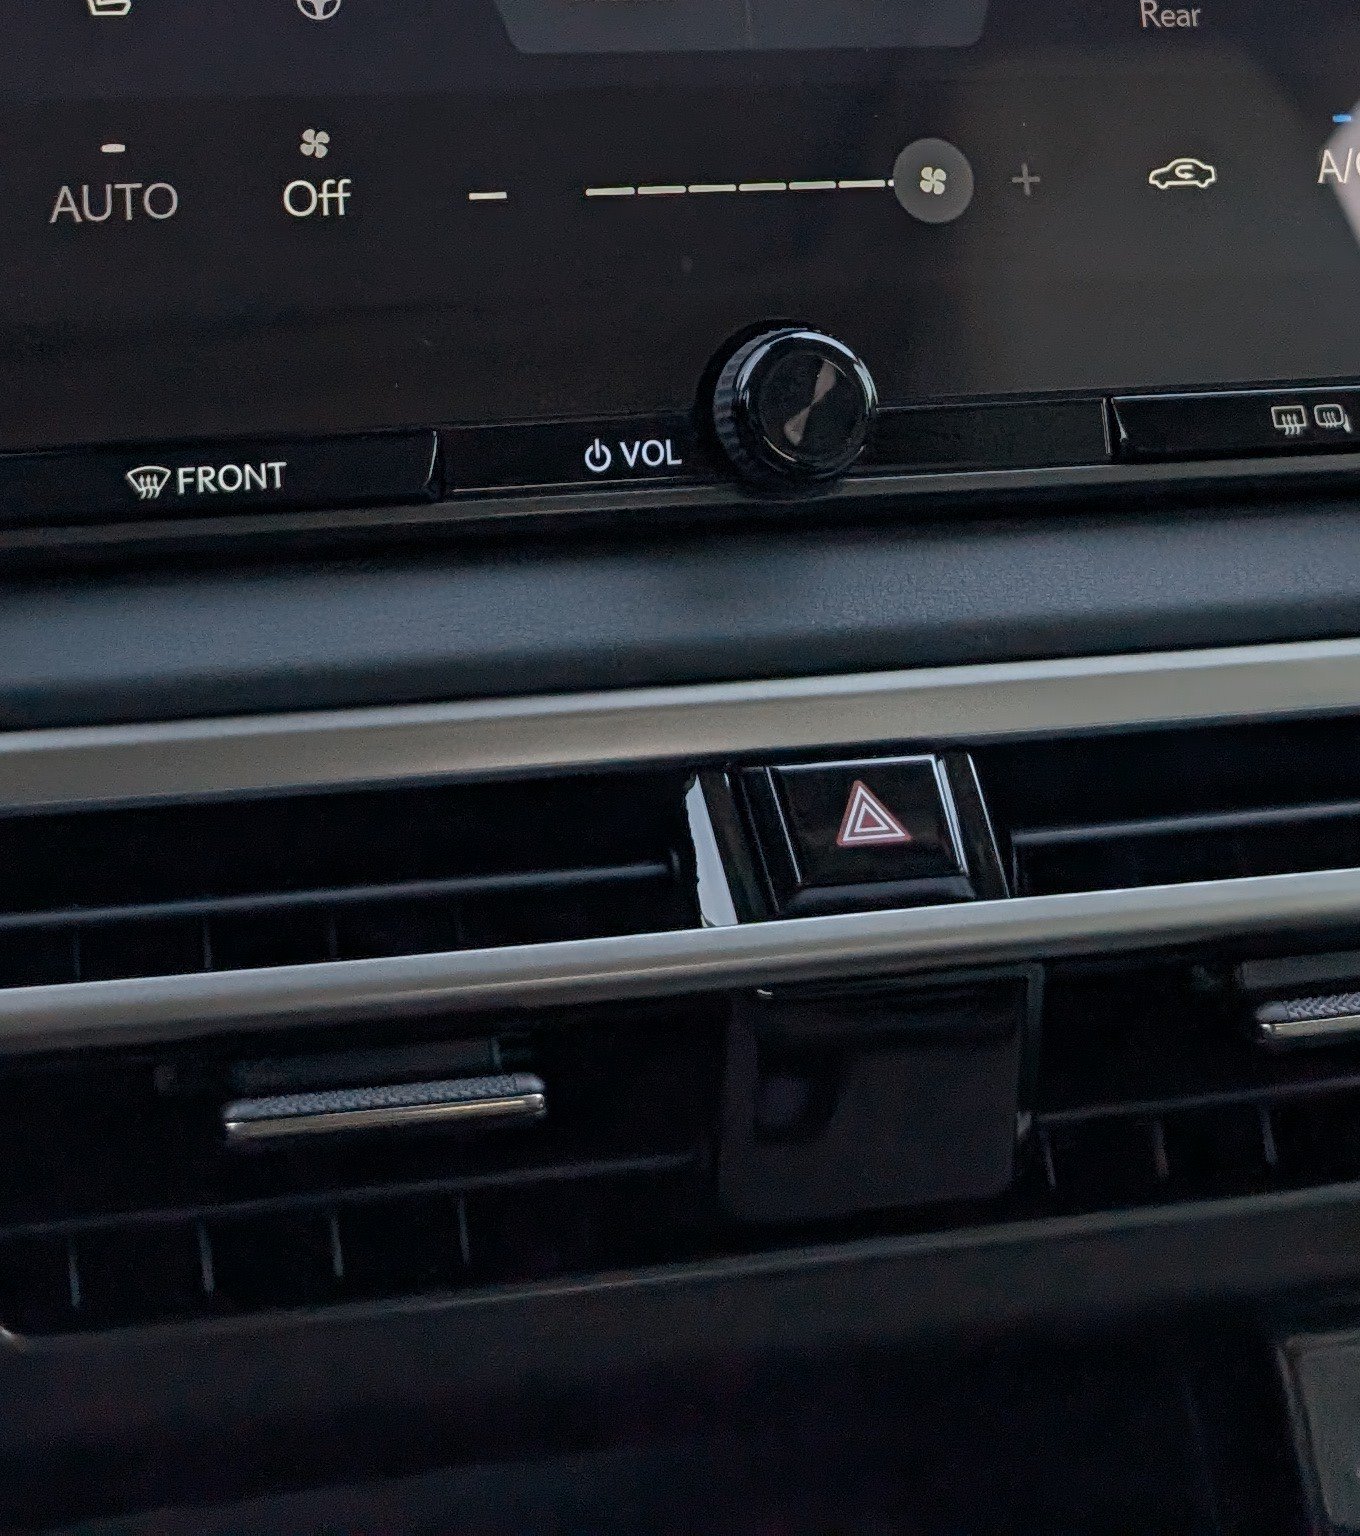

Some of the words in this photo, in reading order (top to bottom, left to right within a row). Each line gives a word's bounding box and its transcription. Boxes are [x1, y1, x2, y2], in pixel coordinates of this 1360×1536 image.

[1140, 0, 1201, 28] Rear
[49, 182, 179, 224] AUTO
[283, 178, 352, 217] Off
[618, 439, 683, 469] VOL
[175, 462, 288, 495] FRONT
